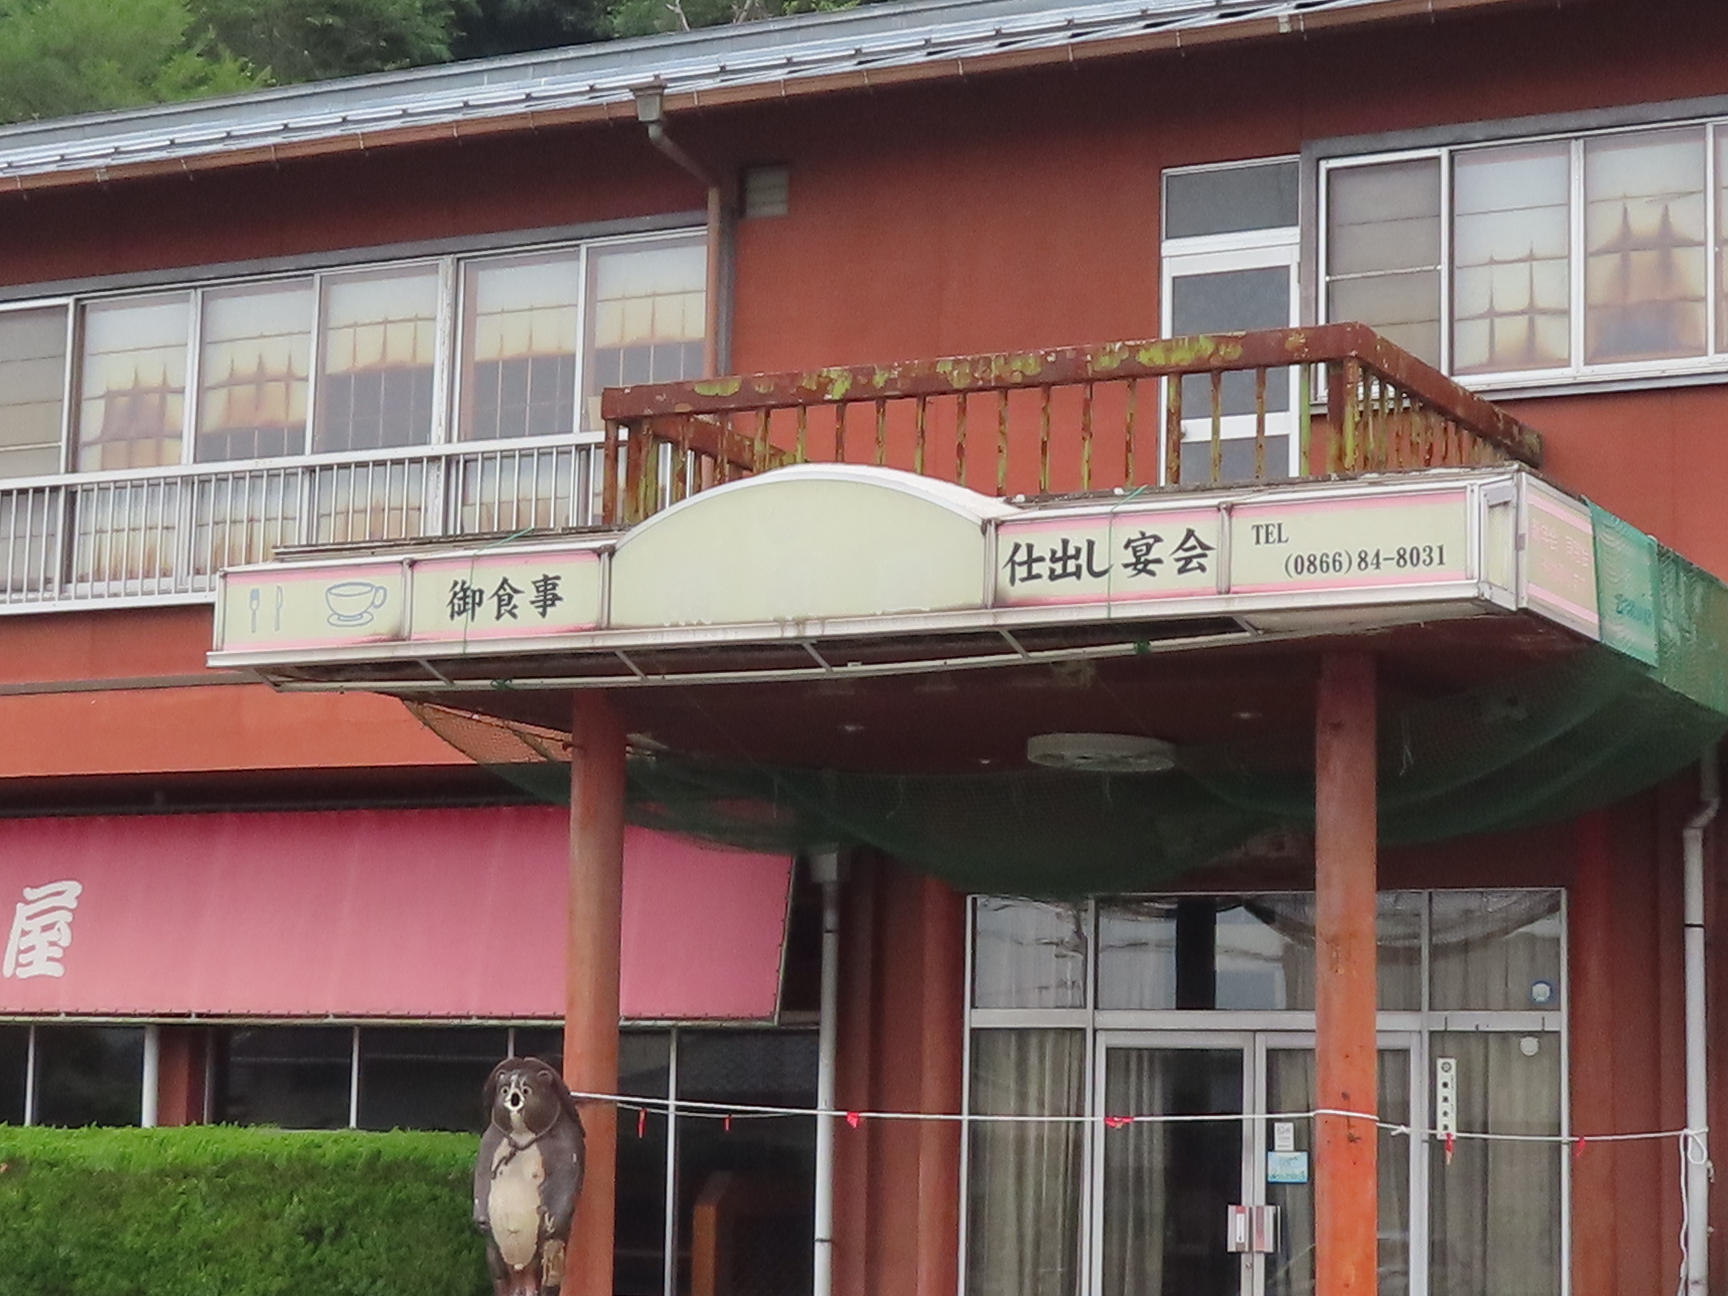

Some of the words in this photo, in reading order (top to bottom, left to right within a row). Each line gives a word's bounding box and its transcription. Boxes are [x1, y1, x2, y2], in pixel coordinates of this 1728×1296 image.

[1252, 523, 1289, 545] TEL
[1284, 545, 1446, 578] (0866)84-8031
[446, 573, 564, 622] 御食事
